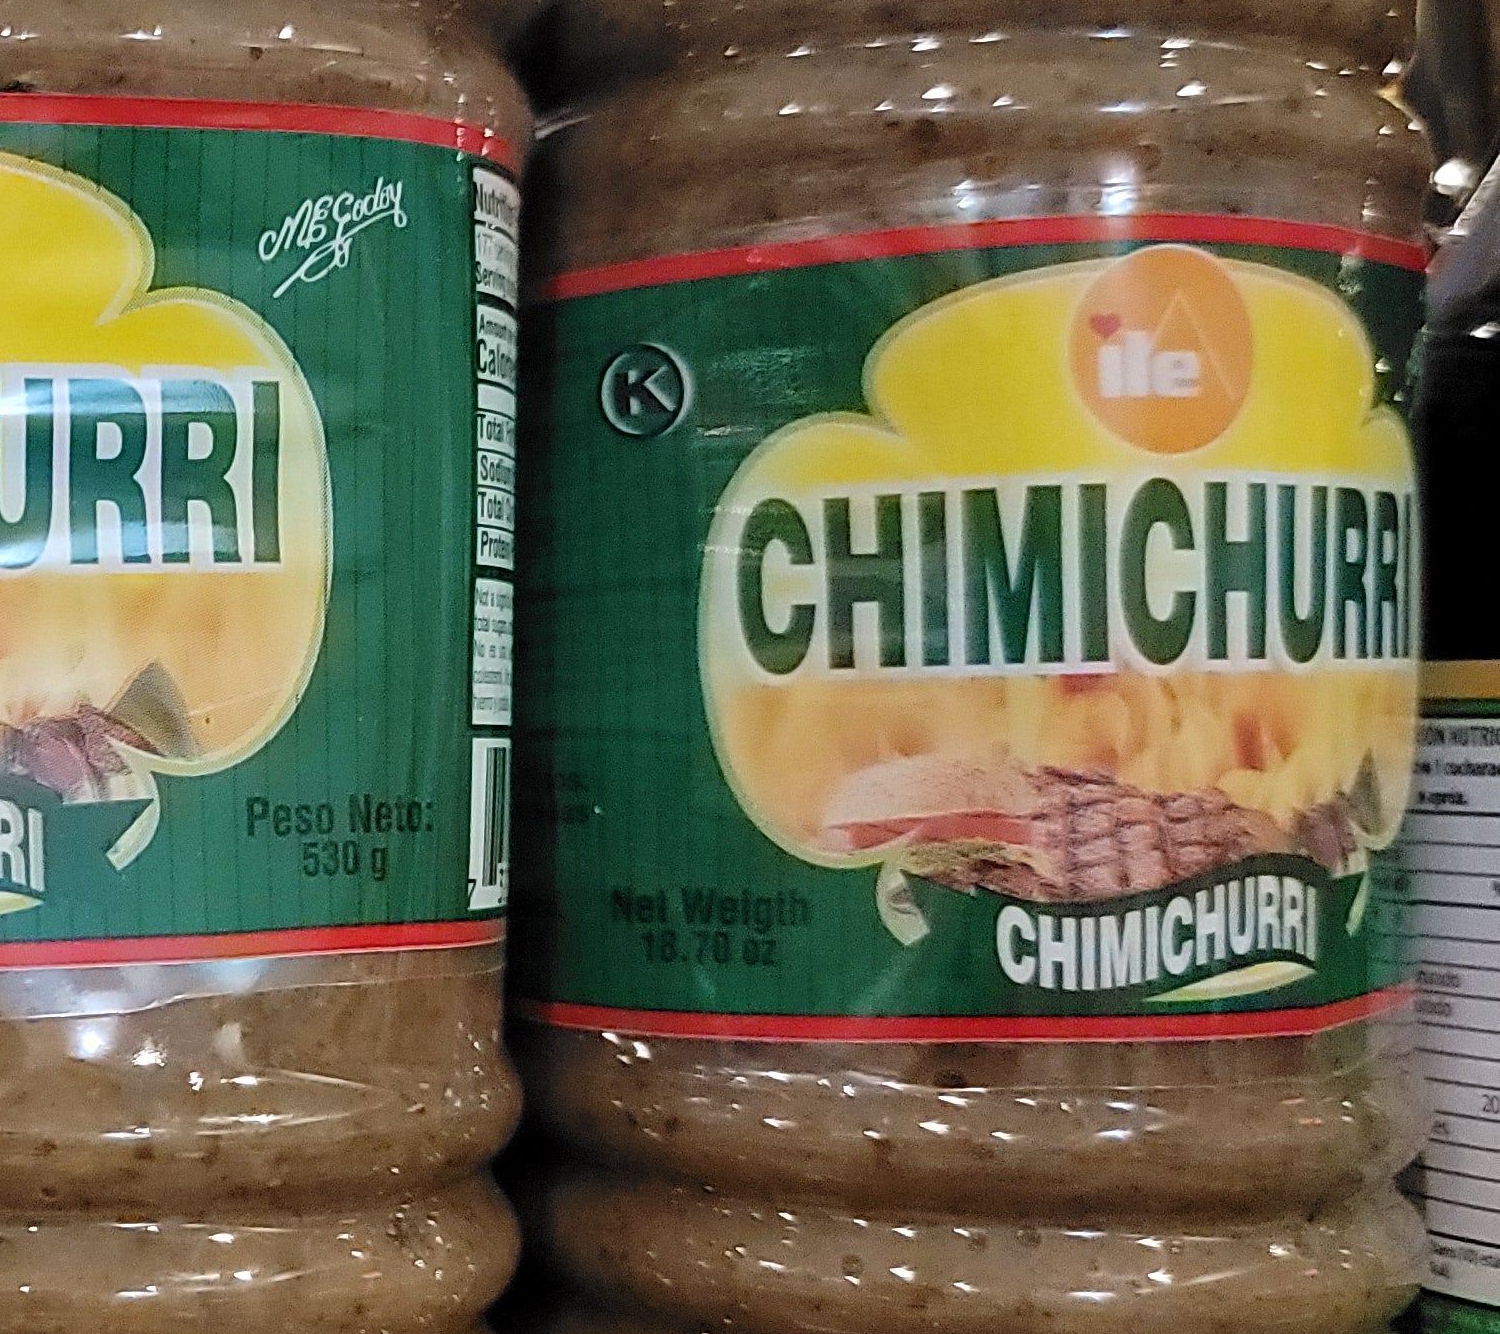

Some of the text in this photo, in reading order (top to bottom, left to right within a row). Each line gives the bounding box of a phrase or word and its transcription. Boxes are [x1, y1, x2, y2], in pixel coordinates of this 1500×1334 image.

[1089, 312, 1200, 398] ile
[247, 793, 435, 837] Peso Neto:
[302, 842, 388, 881] 530 g
[996, 874, 1317, 991] CHIMICHURRI
